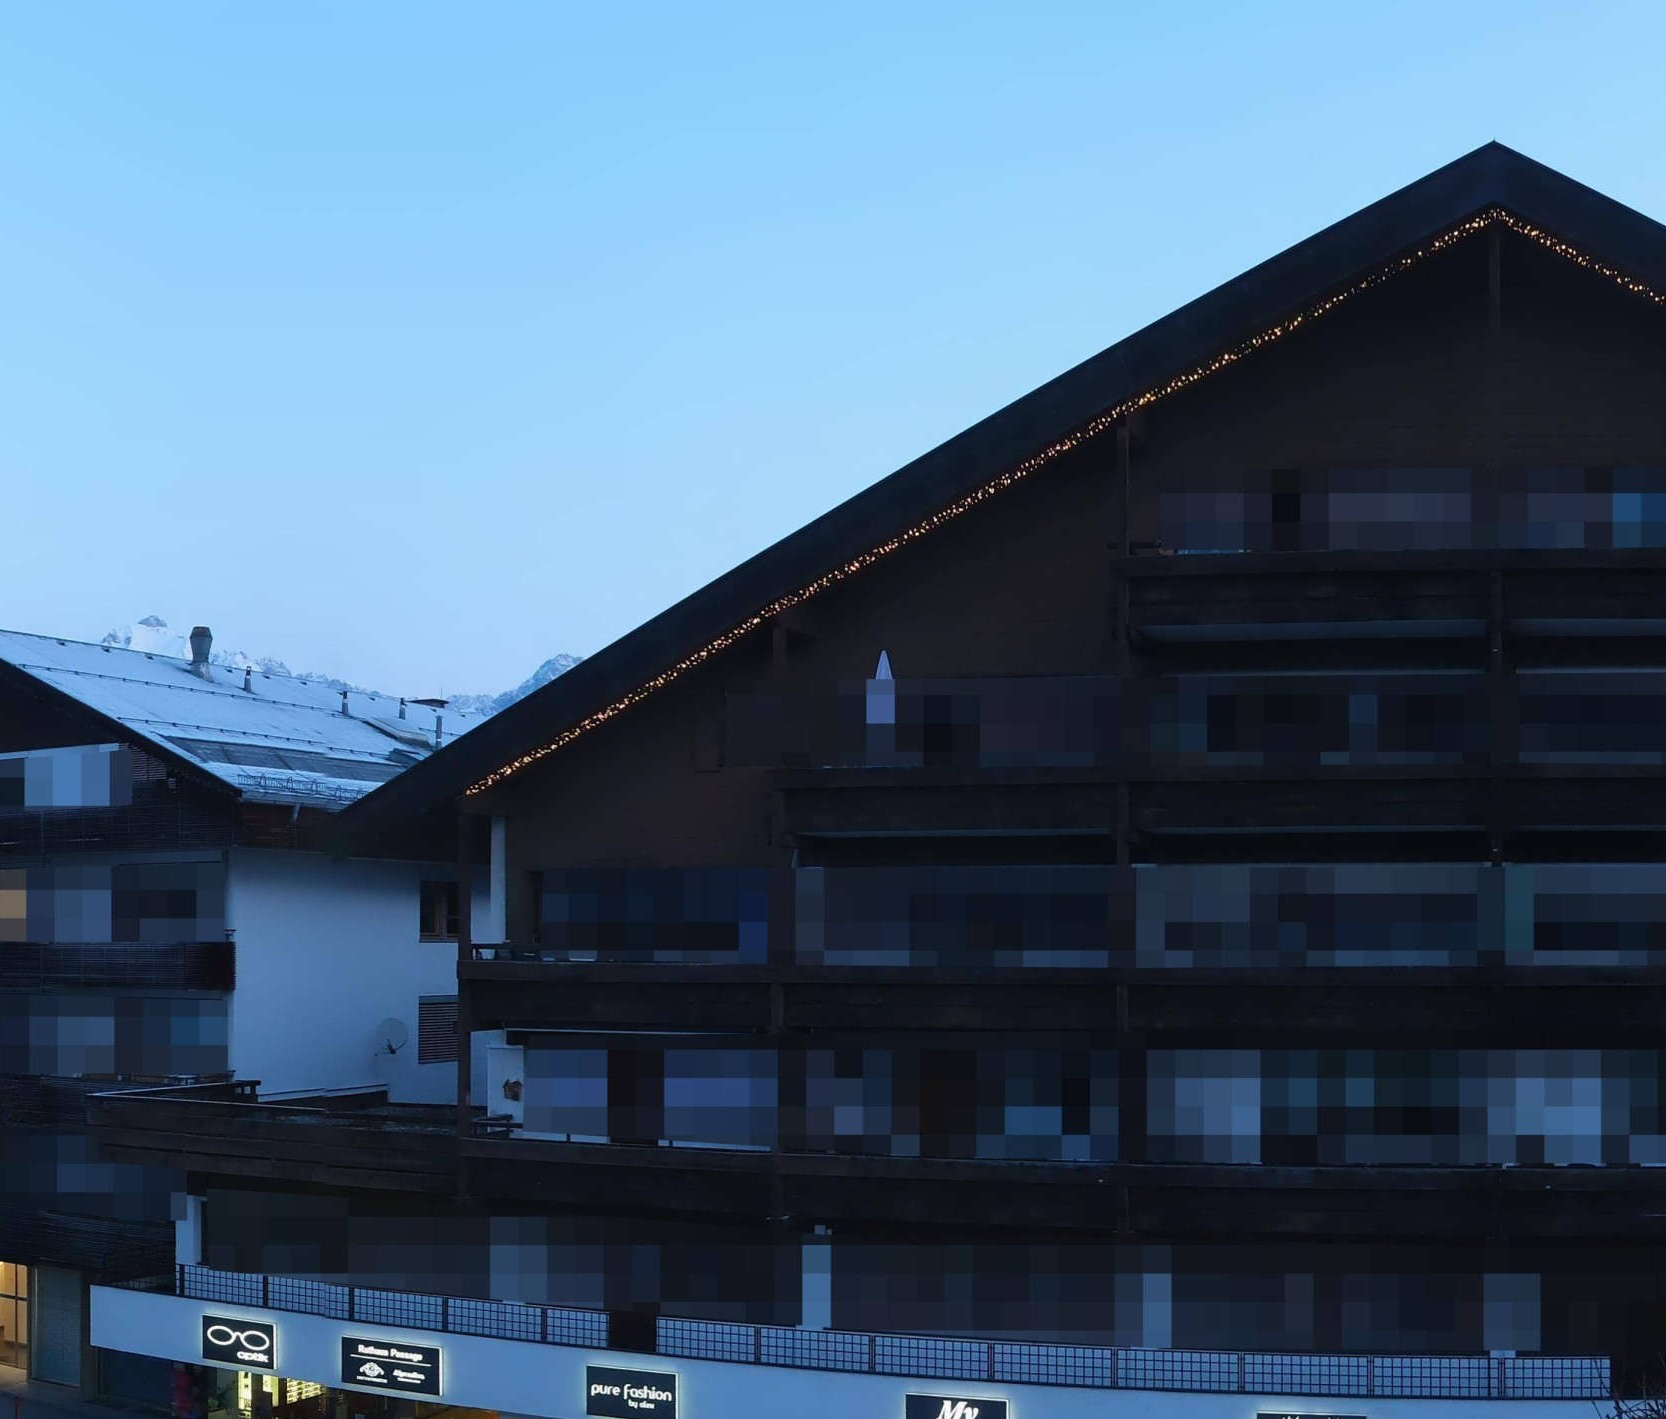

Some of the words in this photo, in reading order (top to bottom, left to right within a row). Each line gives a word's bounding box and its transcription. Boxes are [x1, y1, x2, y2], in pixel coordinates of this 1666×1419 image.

[236, 1351, 270, 1363] optik
[390, 1348, 423, 1362] Passage
[590, 1383, 621, 1397] pure
[623, 1383, 673, 1402] fashion
[628, 1399, 638, 1410] by
